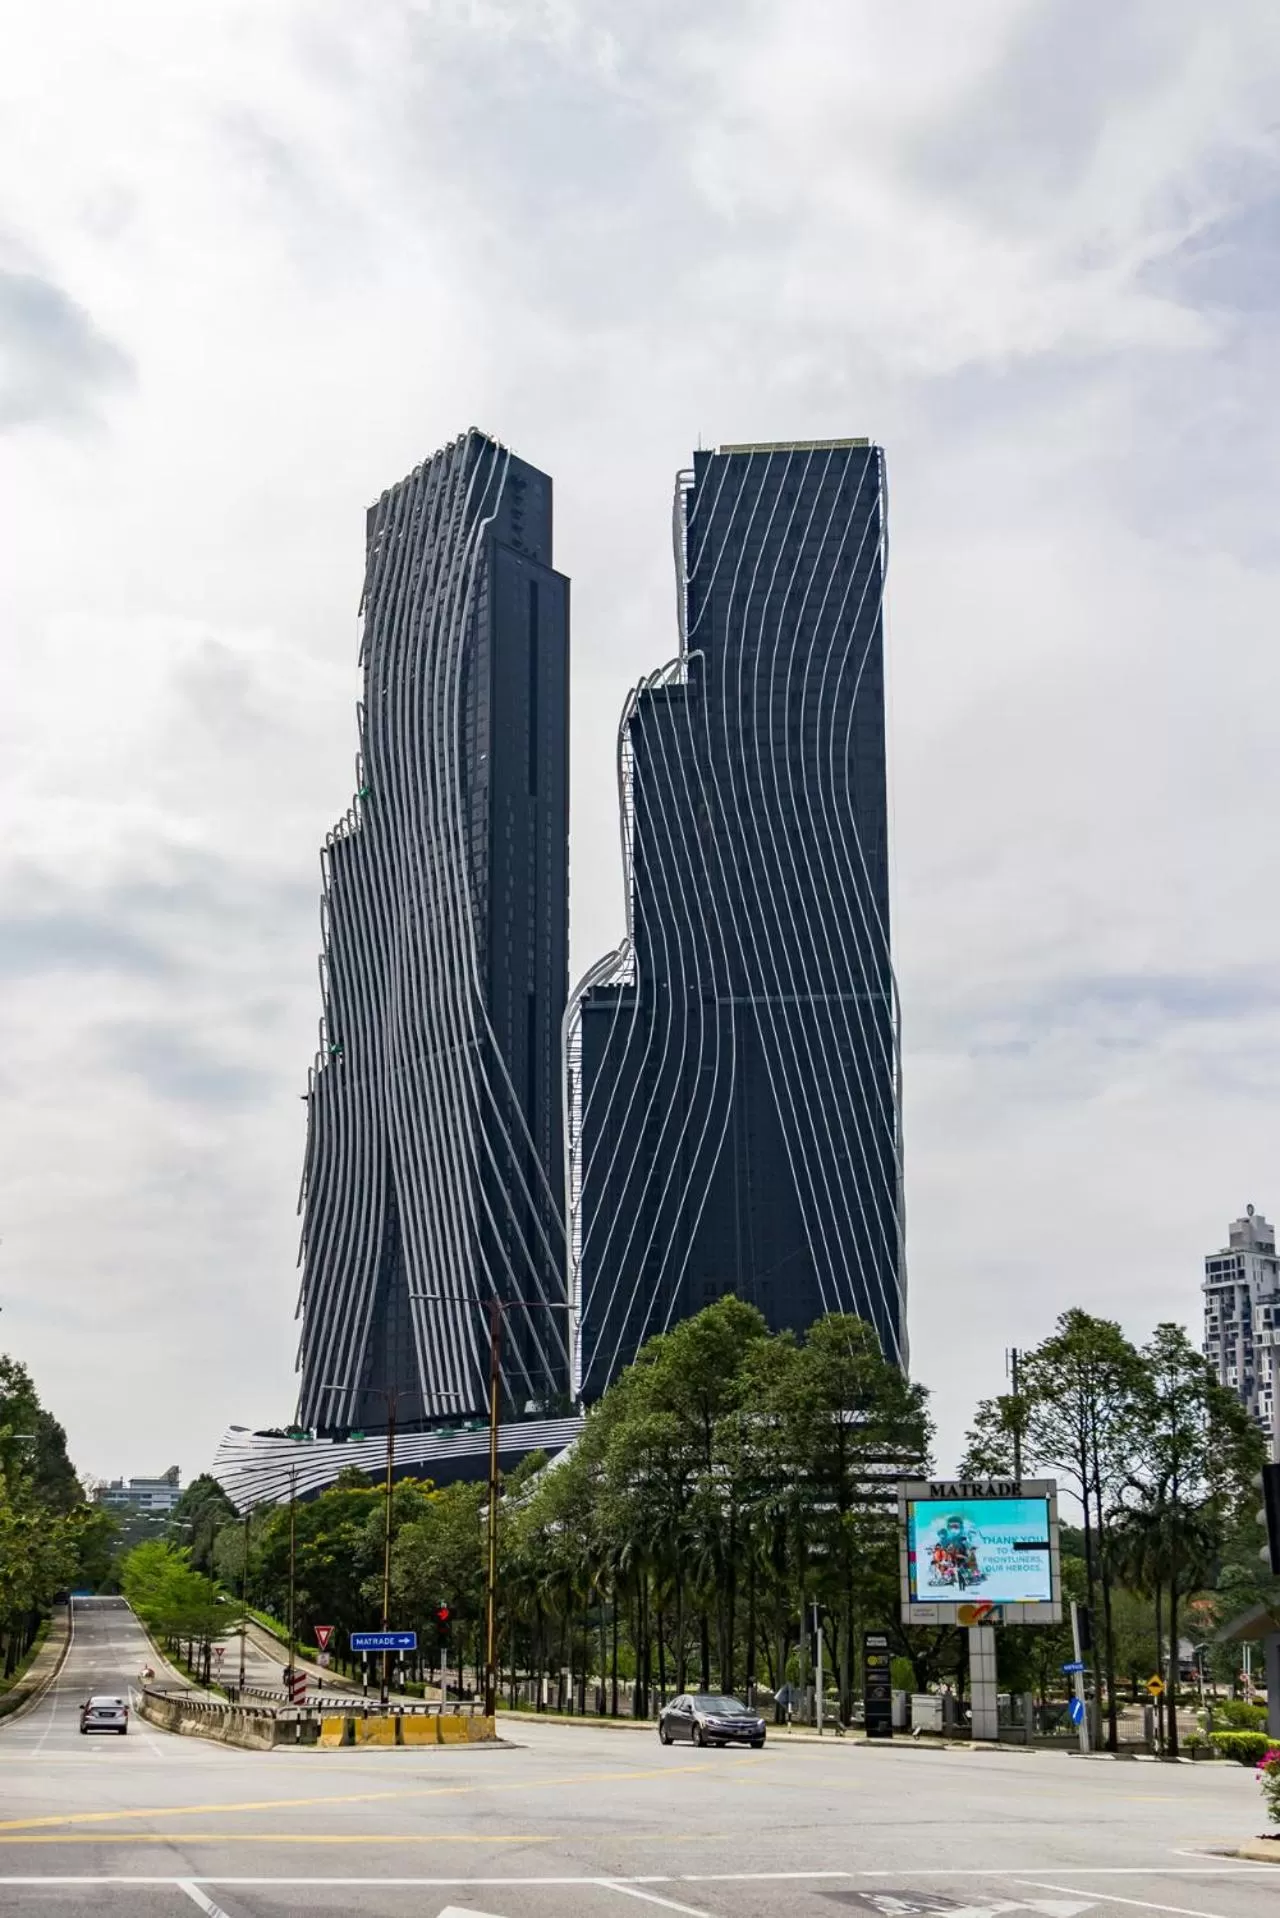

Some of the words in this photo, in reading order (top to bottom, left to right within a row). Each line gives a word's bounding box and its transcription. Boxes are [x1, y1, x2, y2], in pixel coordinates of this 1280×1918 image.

[929, 1482, 1023, 1497] MATRADE
[982, 1535, 1018, 1545] THANK
[985, 1564, 1004, 1573] OUR
[356, 1637, 395, 1645] MATRADE
